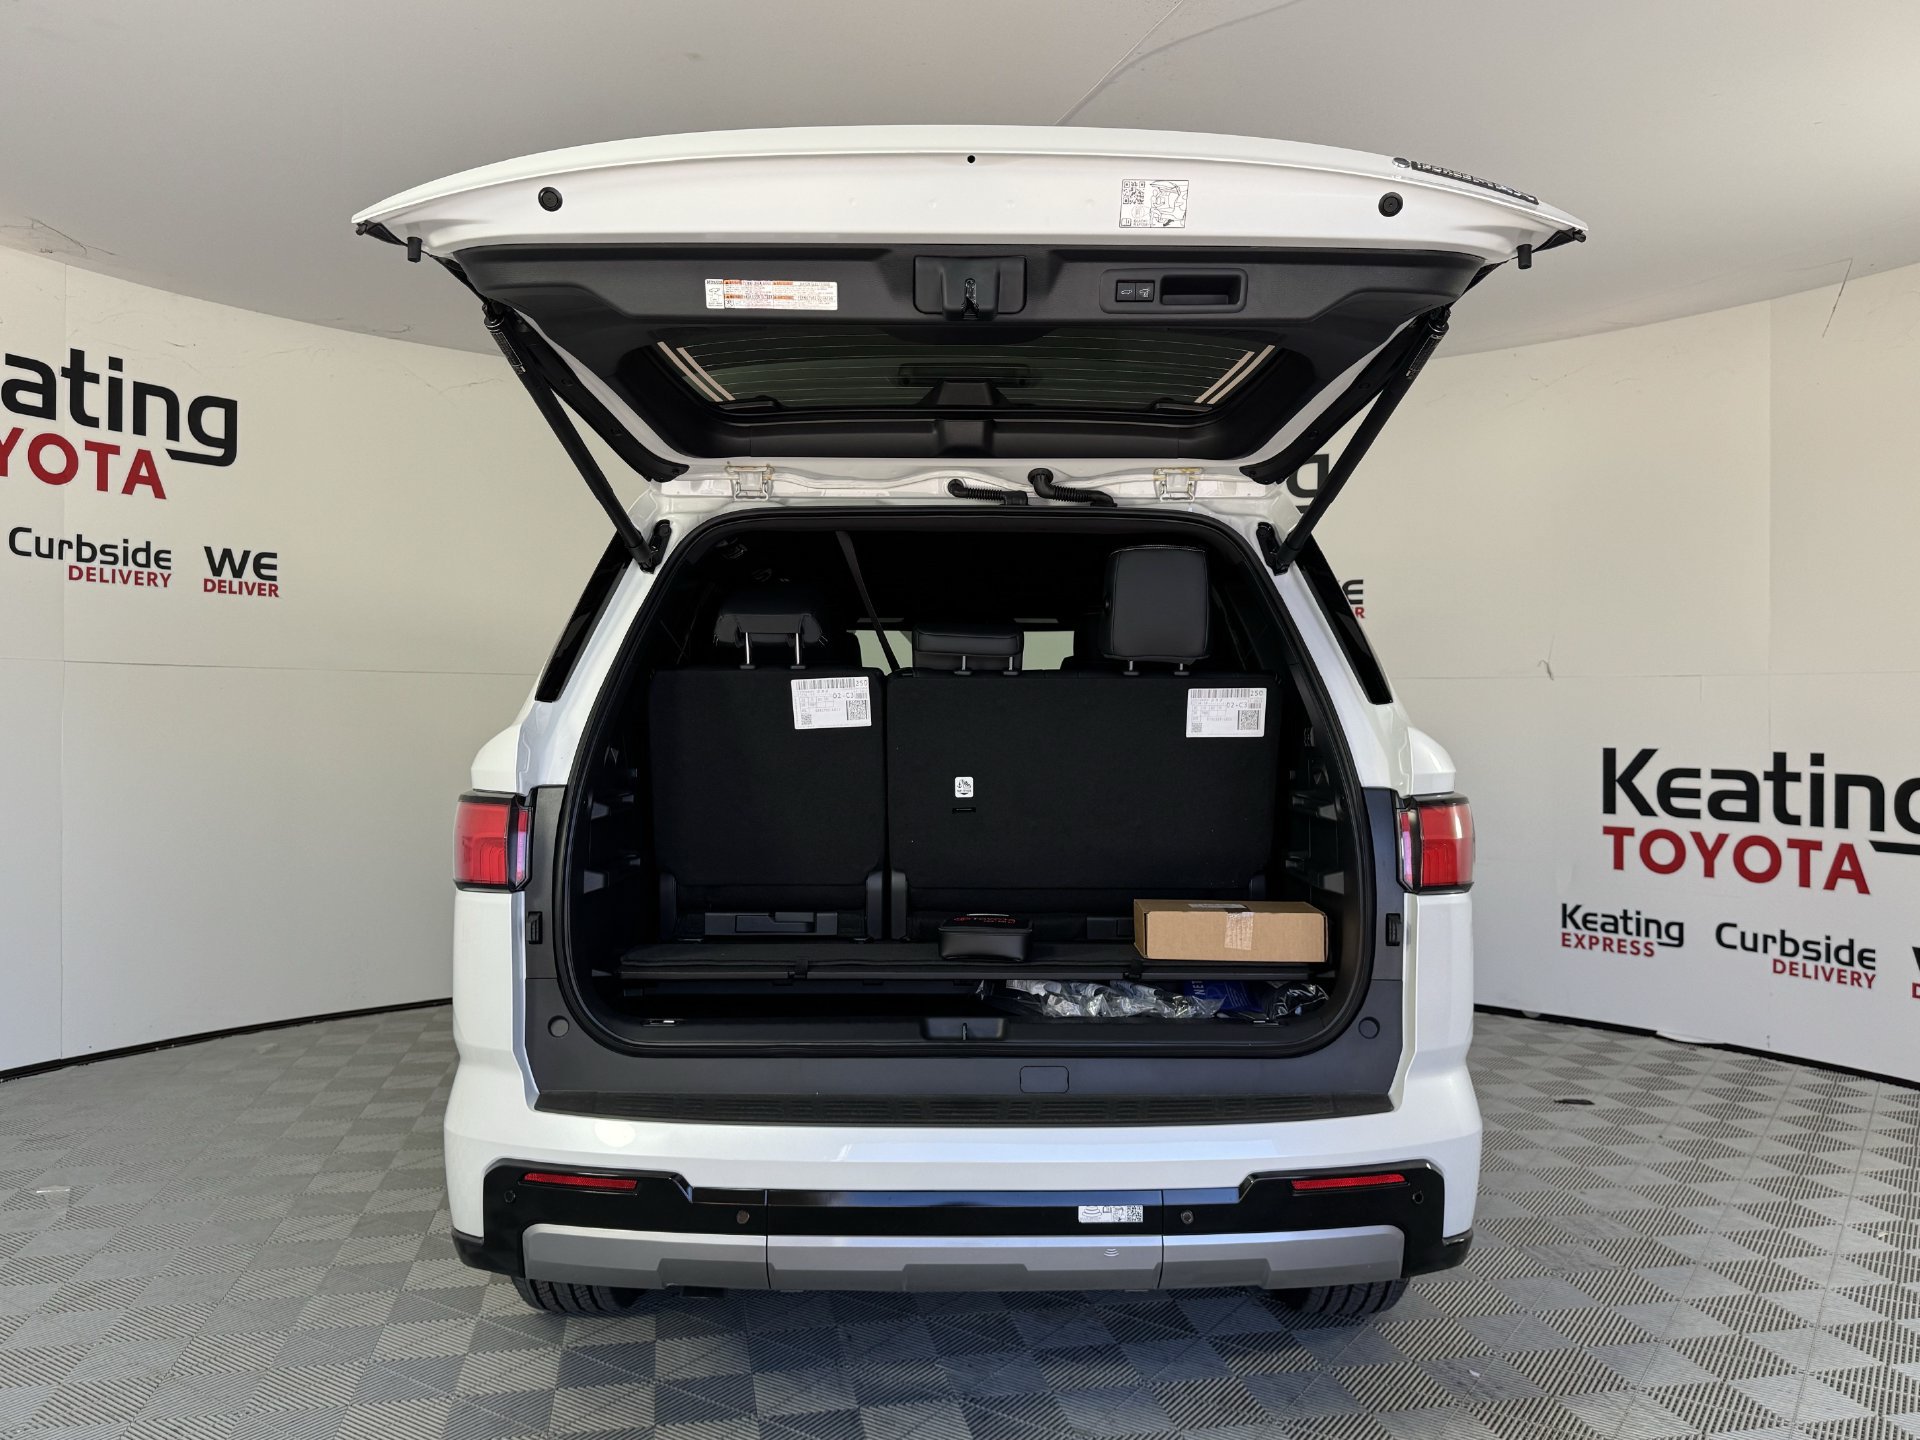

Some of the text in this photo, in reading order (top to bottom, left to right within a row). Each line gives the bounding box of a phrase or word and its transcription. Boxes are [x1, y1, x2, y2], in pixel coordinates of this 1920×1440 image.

[1, 348, 238, 467] ating
[9, 526, 172, 570] Curbside
[204, 546, 278, 581] WE
[68, 565, 172, 588] DELIVERY
[203, 578, 279, 598] DELIVER
[1602, 826, 1870, 895] TOYOTA
[1561, 903, 1684, 948] Keating
[1561, 932, 1655, 957] EXPRESS
[1715, 922, 1876, 970] Curbside
[1772, 958, 1876, 989] DELIVERY
